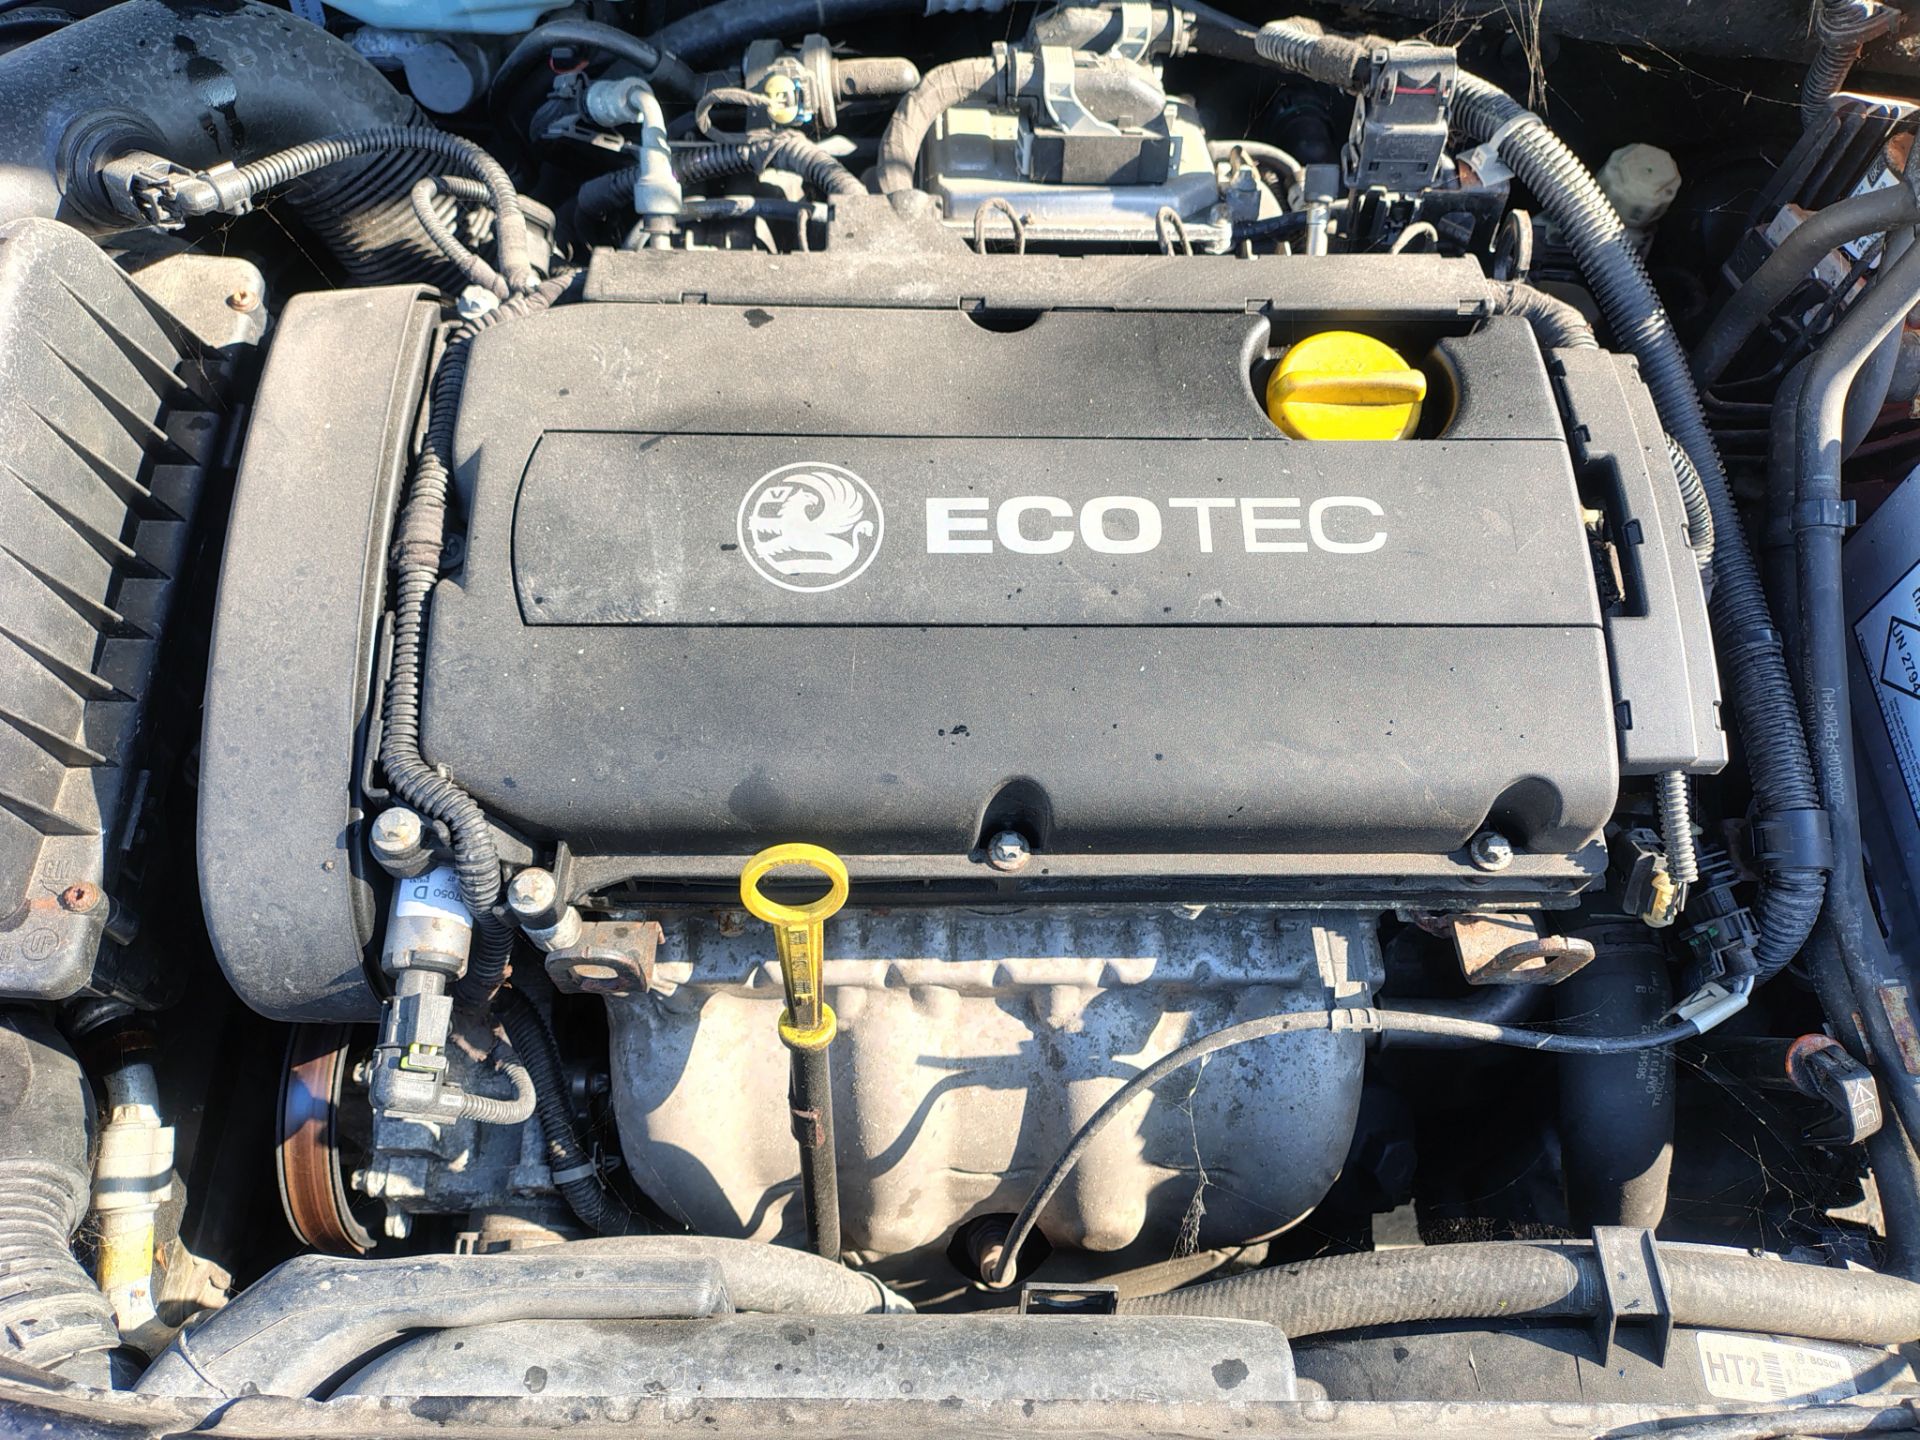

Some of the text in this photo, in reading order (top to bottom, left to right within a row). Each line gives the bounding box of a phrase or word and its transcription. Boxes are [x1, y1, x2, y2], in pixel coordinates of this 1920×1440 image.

[926, 496, 1388, 554] ECOTEC
[1892, 623, 1907, 650] UN
[1901, 652, 1920, 694] 2794
[413, 885, 428, 899] D
[1706, 1352, 1764, 1388] HT2
[1809, 1355, 1841, 1369] BOSCH
